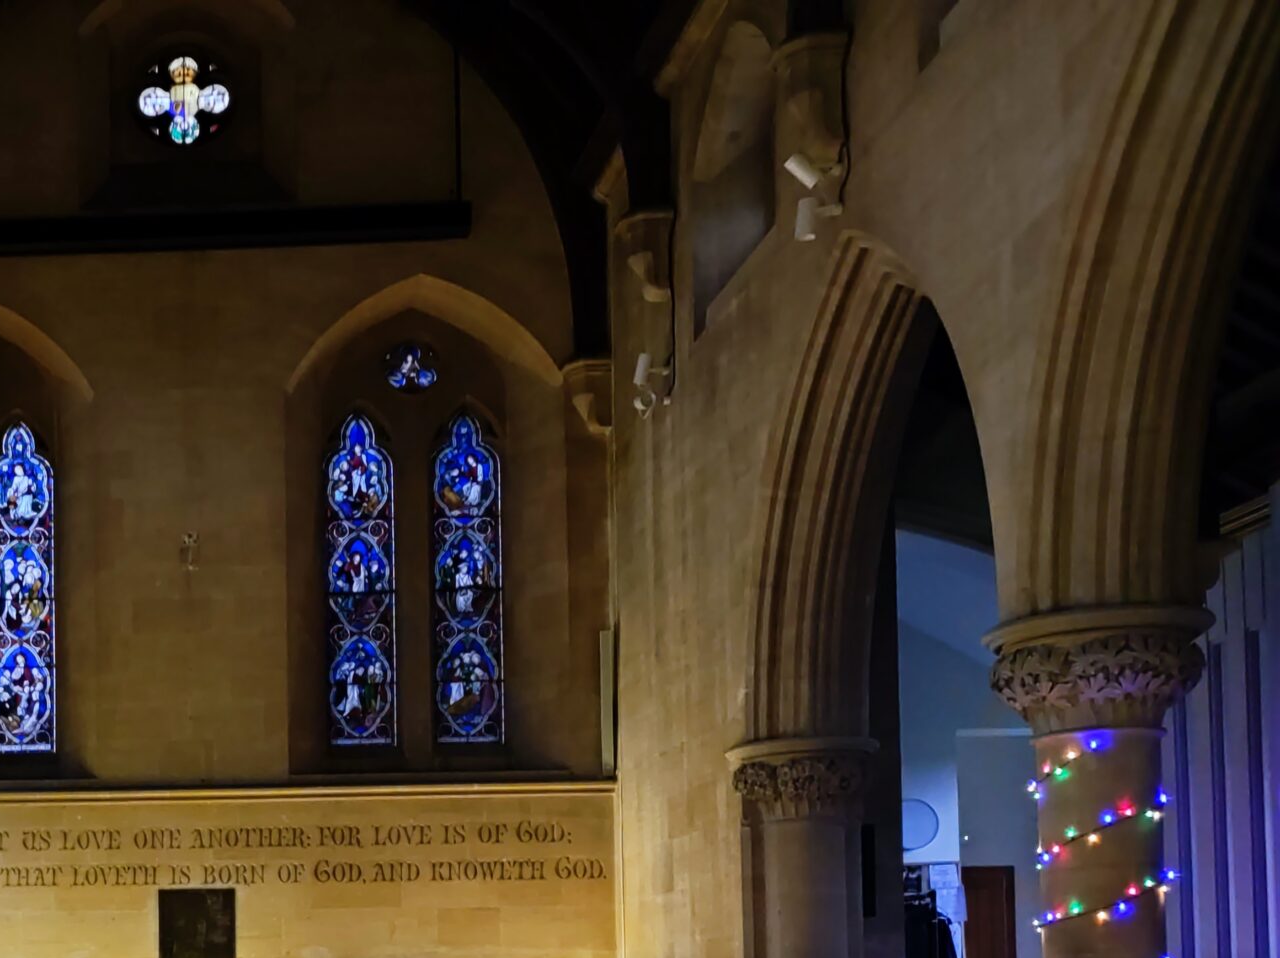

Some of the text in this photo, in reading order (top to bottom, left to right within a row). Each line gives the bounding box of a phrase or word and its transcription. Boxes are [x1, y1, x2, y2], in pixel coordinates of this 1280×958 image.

[22, 829, 52, 852] US
[58, 828, 121, 852] LOVE
[133, 827, 182, 851] ONE
[190, 826, 312, 850] ANOTHER:
[317, 825, 363, 848] FOR
[371, 824, 432, 847] LOVE
[440, 824, 466, 846] IS
[477, 823, 508, 845] OF
[515, 820, 573, 846] GOD;
[70, 864, 160, 887] LOVETH
[167, 864, 192, 886] IS
[200, 863, 266, 886] BORN
[277, 862, 306, 884] OF
[313, 859, 366, 885] GOD,
[372, 860, 421, 884] AND
[430, 858, 546, 882] KNOWETH
[554, 855, 608, 881] GOD.
